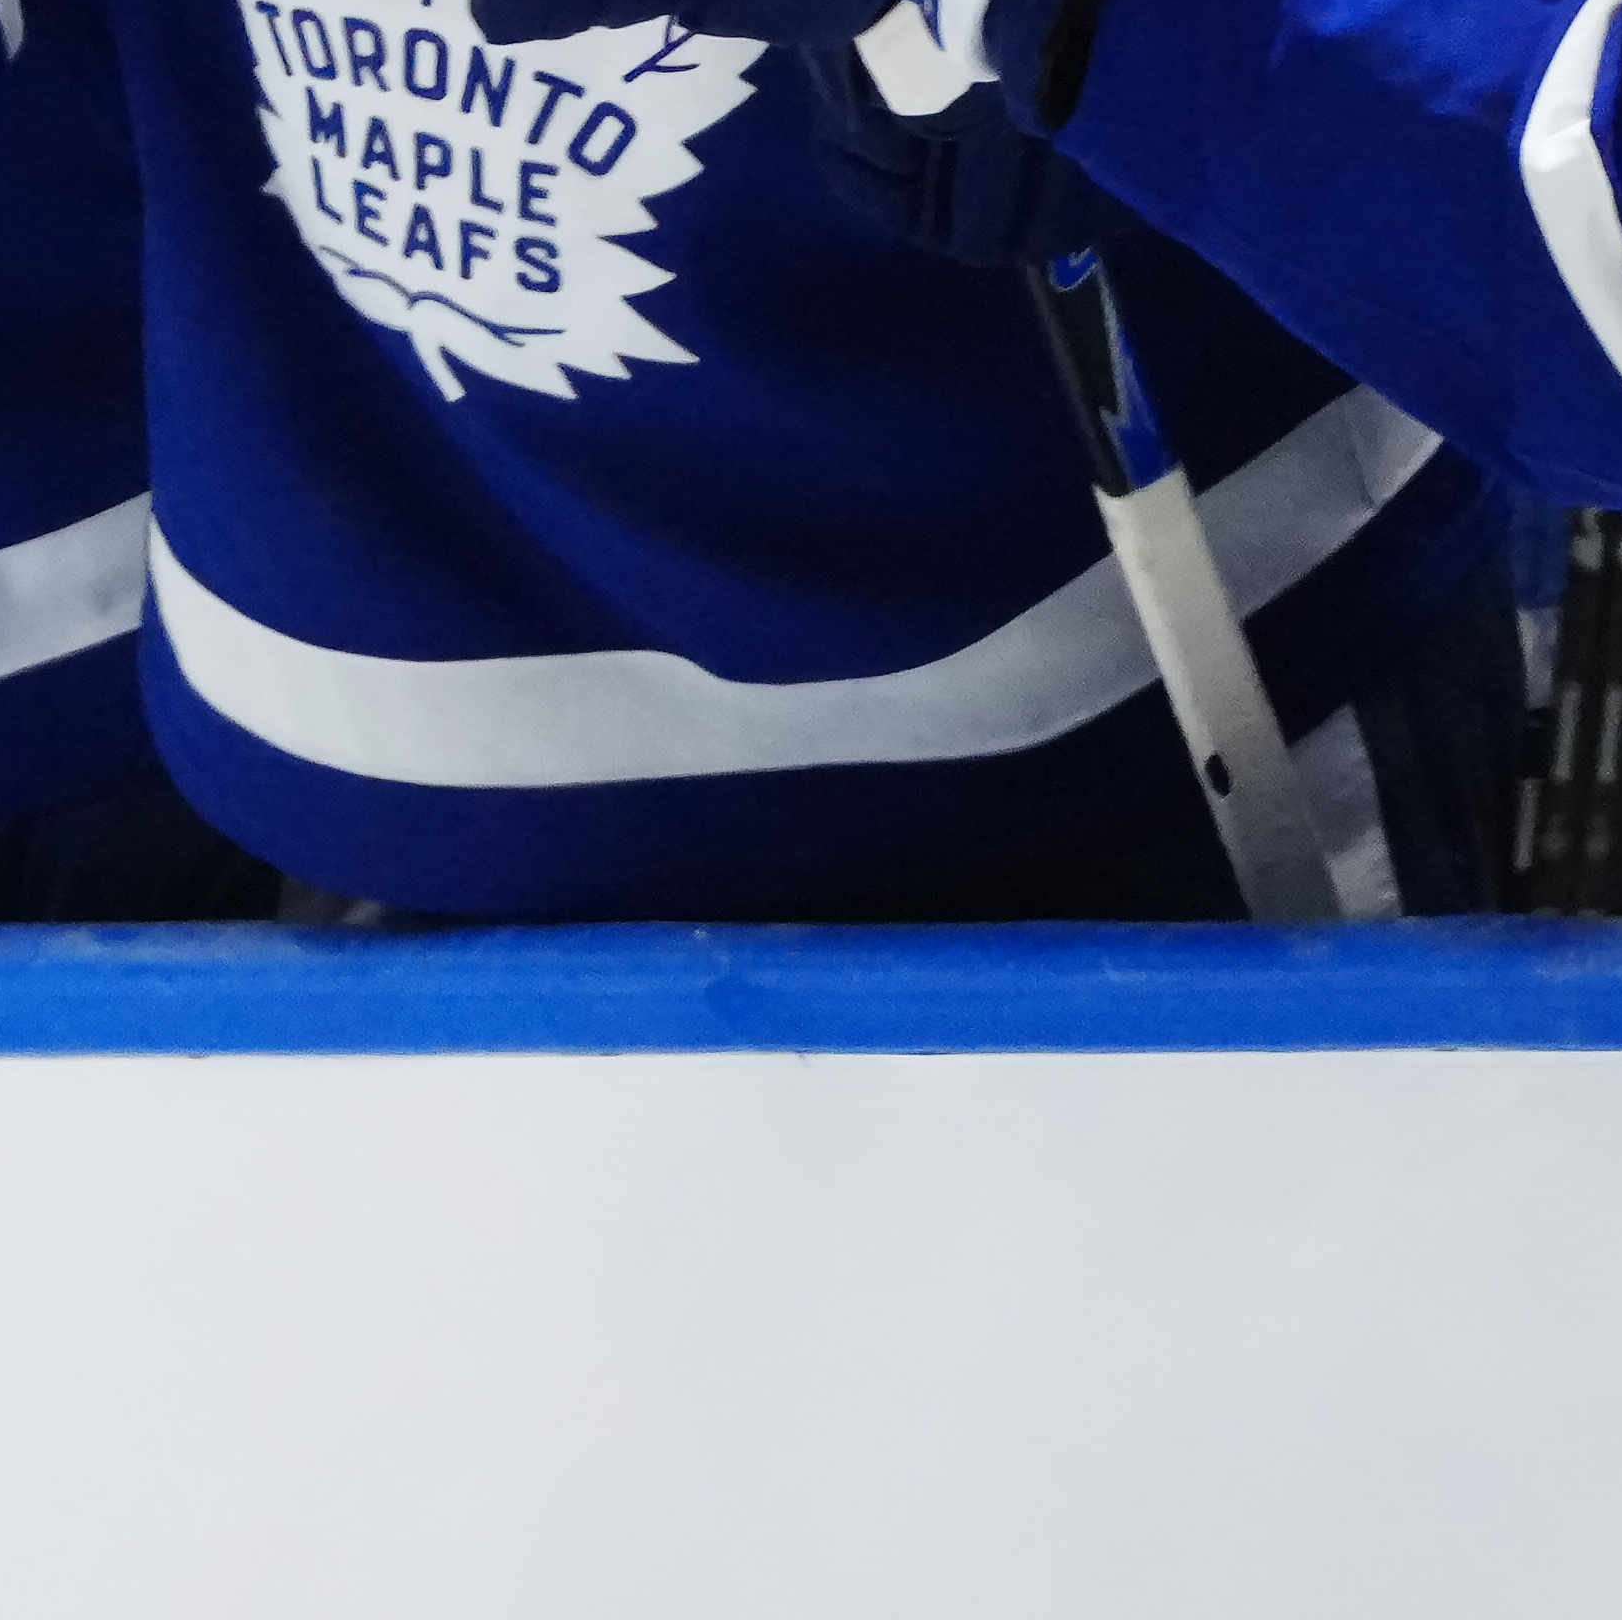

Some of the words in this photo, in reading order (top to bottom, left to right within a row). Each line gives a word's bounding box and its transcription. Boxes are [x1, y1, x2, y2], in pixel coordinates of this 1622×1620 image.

[255, 0, 637, 176] TORONTO
[307, 86, 560, 226] MAPLE
[309, 155, 563, 293] LEAFS
